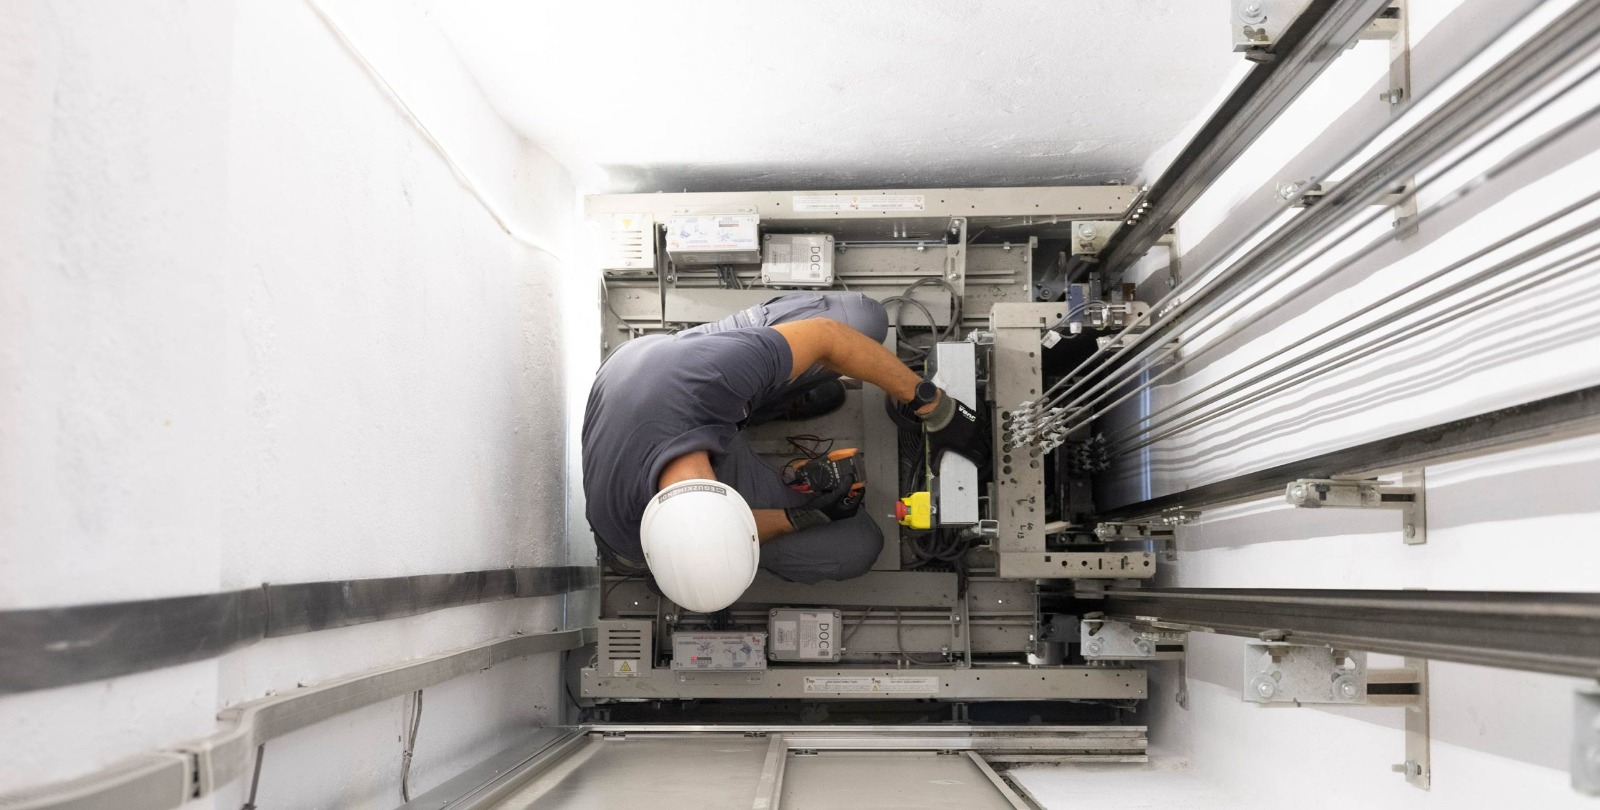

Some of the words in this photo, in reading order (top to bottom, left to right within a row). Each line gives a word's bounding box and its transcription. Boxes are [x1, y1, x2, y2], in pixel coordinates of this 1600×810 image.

[810, 246, 821, 271] DOC
[659, 485, 716, 502] EGUZKIMENDI
[819, 623, 830, 649] DOC
